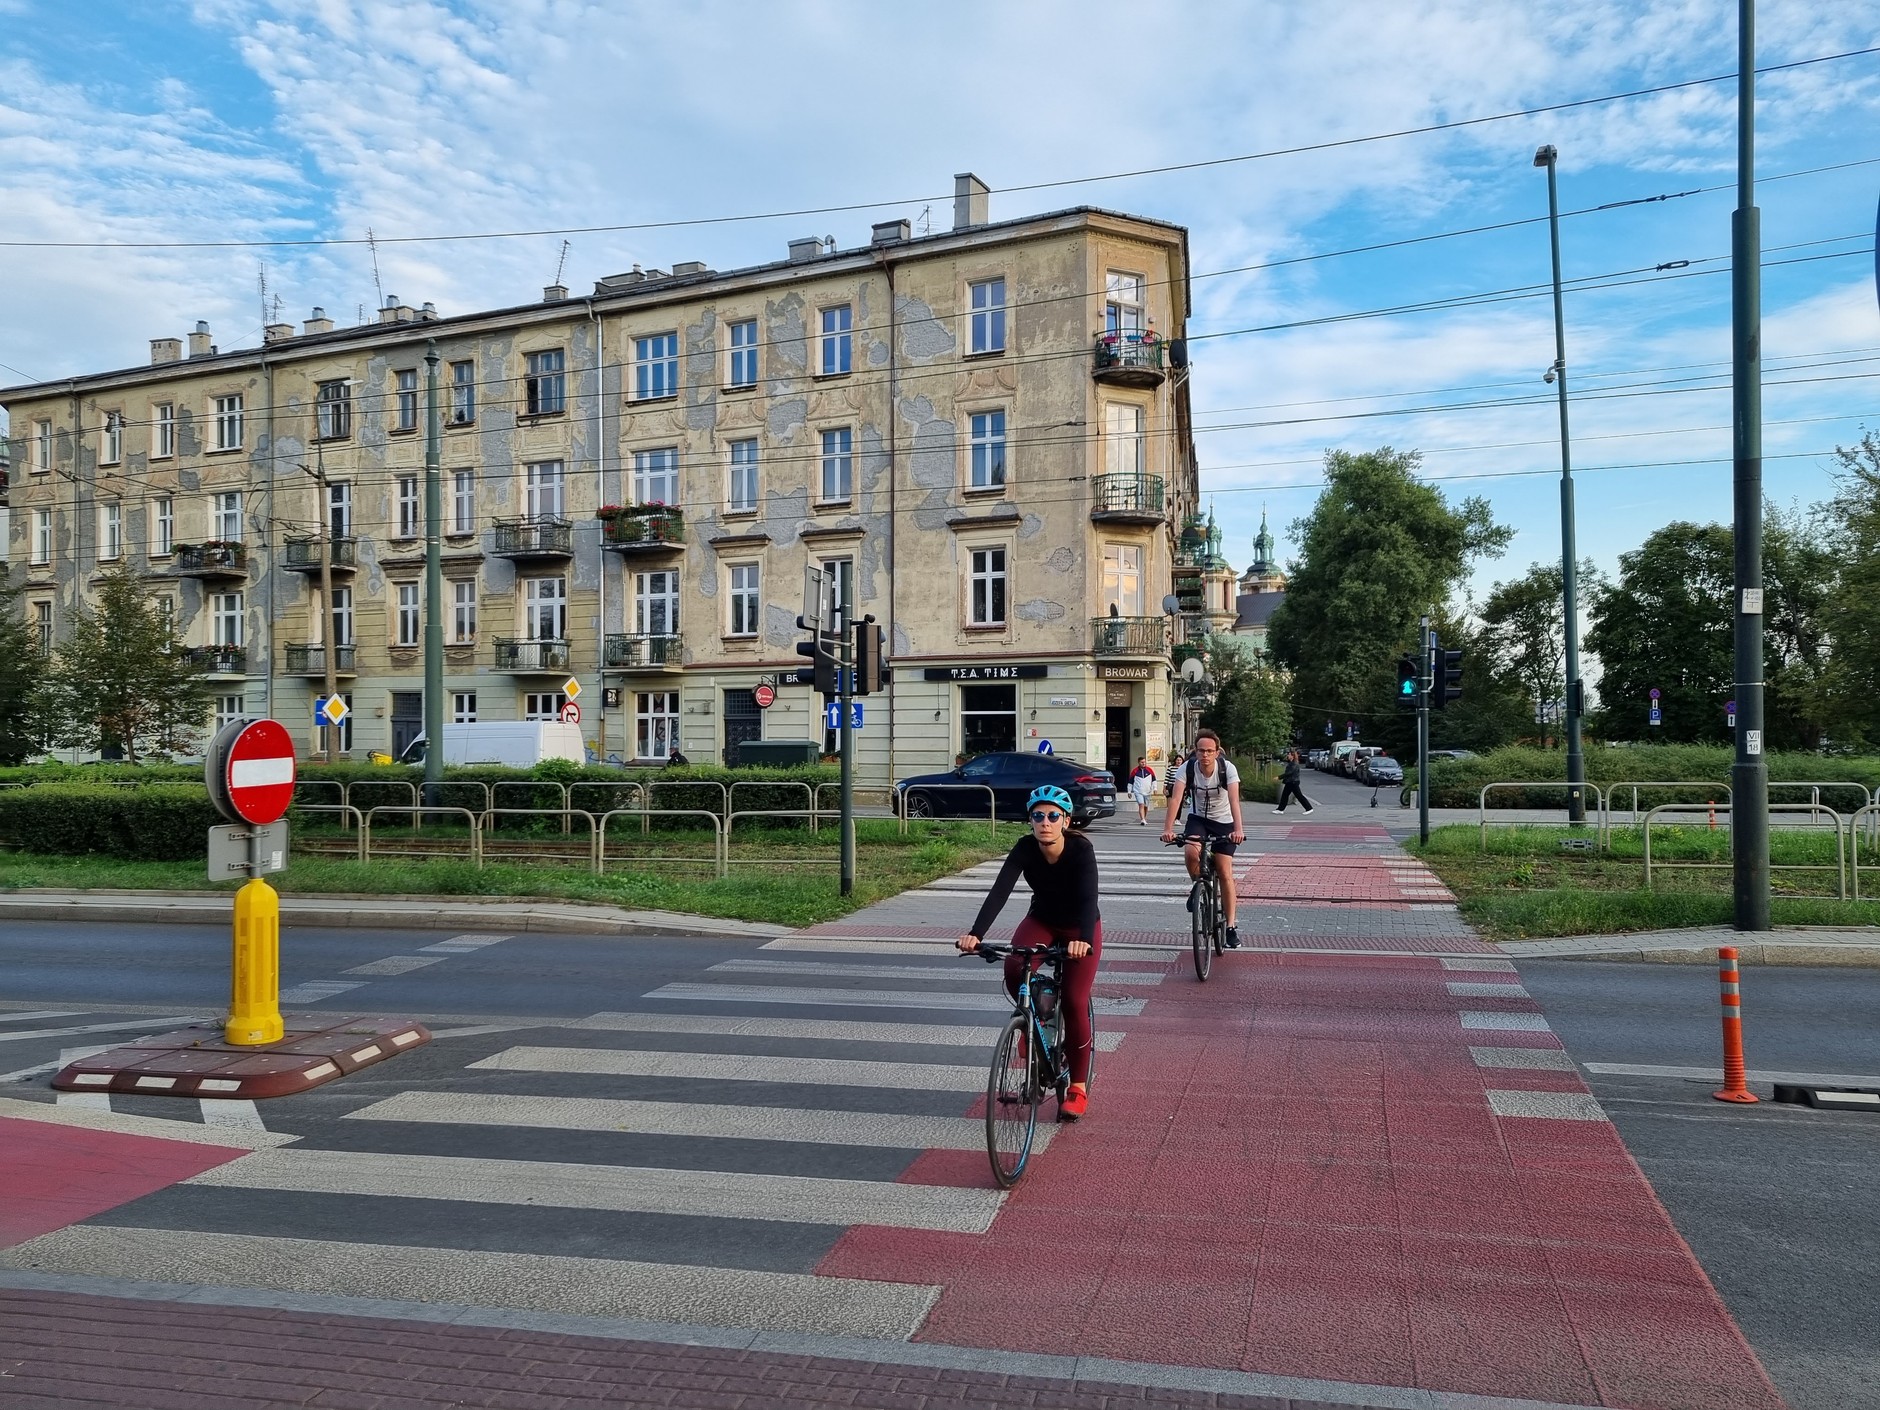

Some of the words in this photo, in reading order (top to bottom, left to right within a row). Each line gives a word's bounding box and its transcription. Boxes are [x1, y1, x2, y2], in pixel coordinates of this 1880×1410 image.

[984, 667, 1018, 678] TIME
[1105, 667, 1148, 678] BROWAR
[1749, 743, 1759, 751] 18
